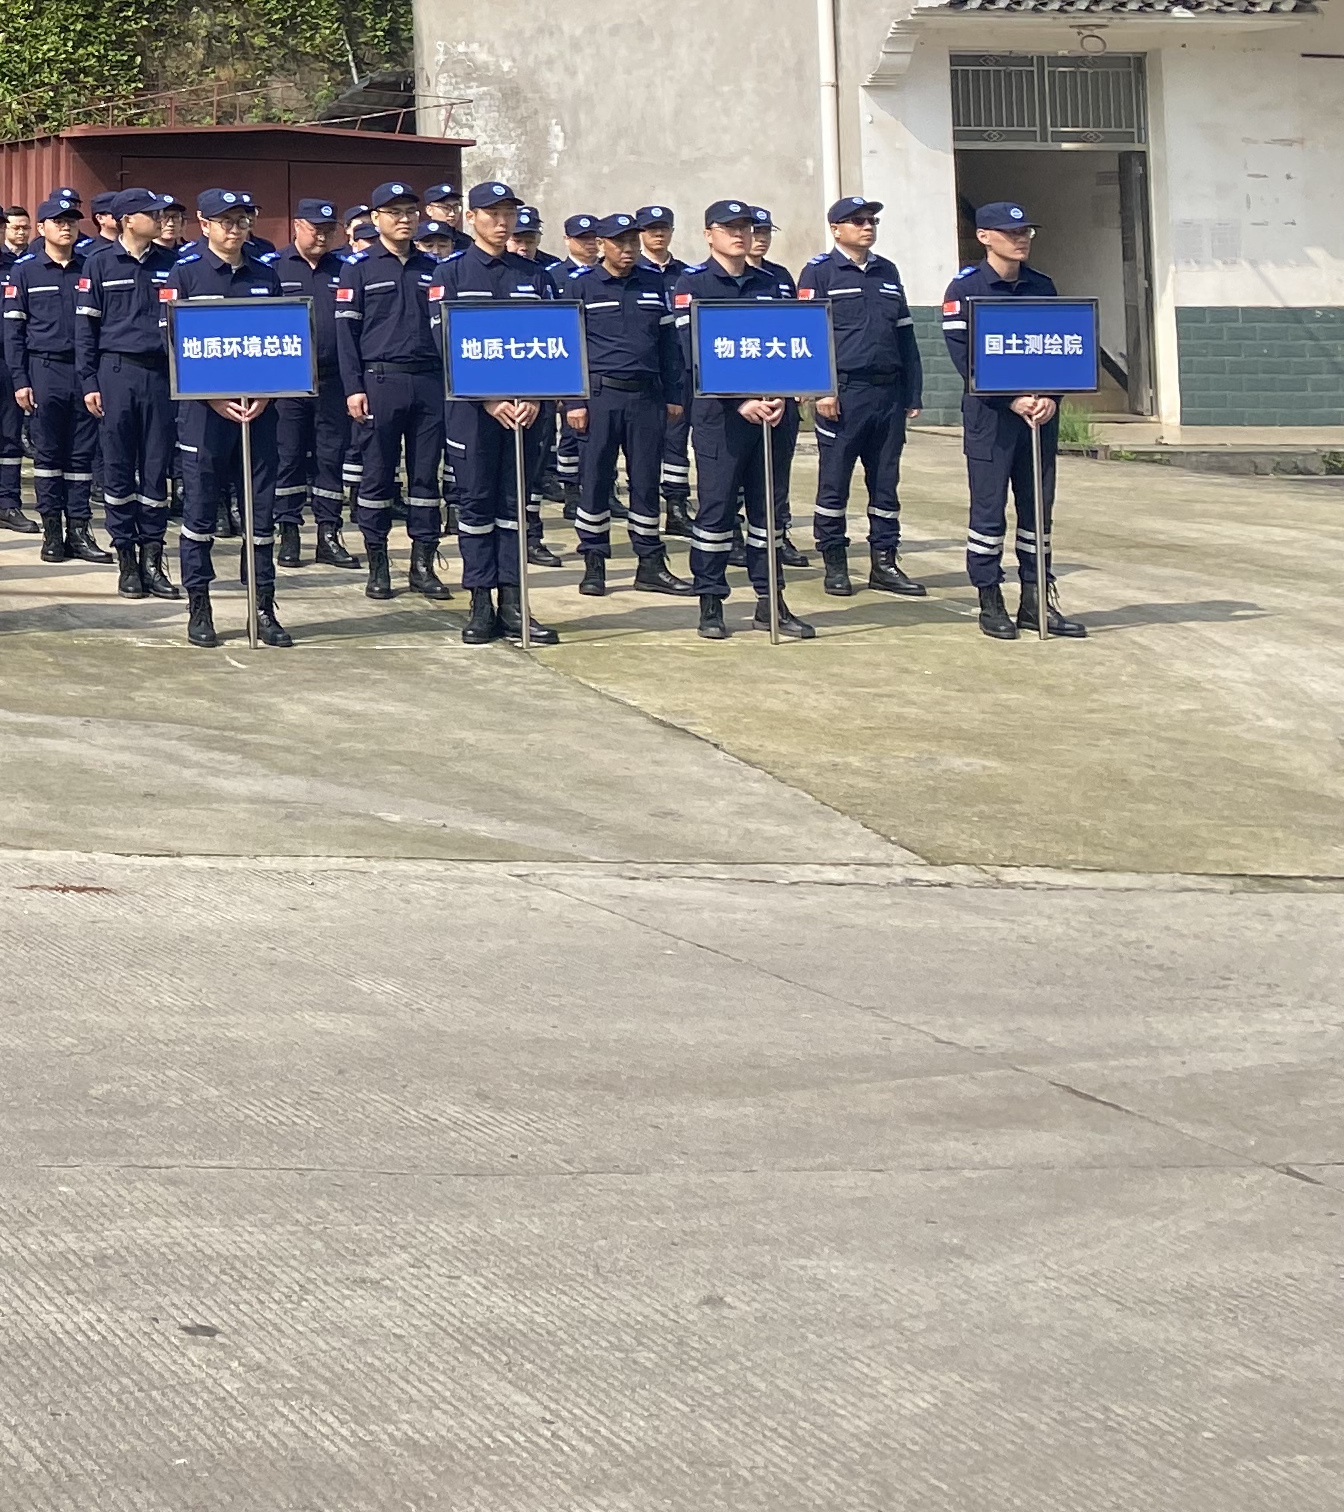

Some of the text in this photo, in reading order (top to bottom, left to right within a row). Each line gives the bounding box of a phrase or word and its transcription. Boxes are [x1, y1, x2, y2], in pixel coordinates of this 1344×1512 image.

[182, 335, 301, 358] 地质环境总站
[461, 336, 568, 359] 地质七大队
[714, 337, 813, 358] 物探大队
[985, 334, 1082, 355] 国土测绘院
